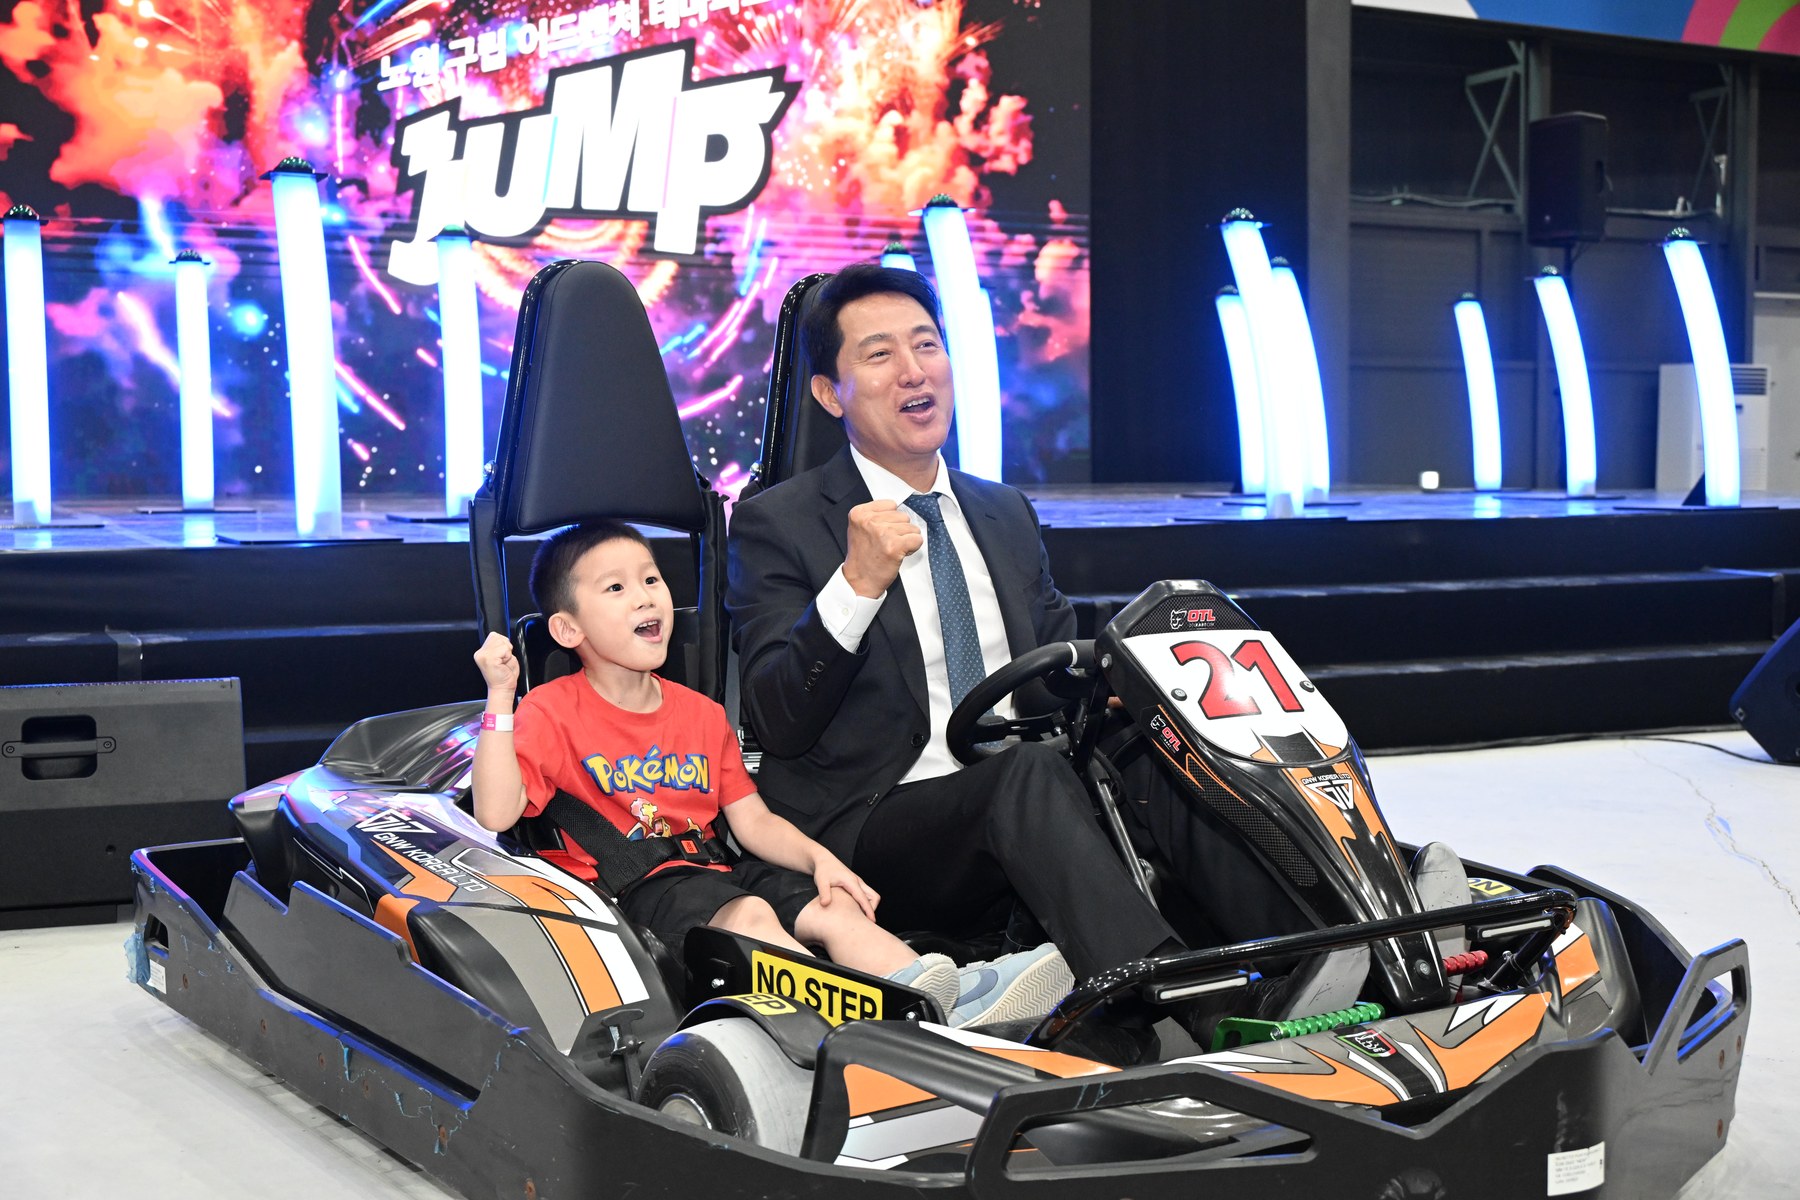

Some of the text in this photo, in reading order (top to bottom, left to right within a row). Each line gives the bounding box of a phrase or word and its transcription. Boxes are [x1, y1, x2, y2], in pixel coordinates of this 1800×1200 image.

[377, 43, 441, 91] 노원
[1187, 609, 1216, 622] OTL
[1170, 640, 1304, 719] 21
[1162, 727, 1181, 751] OTL
[374, 832, 416, 850] GNW
[403, 849, 460, 877] KOREA
[757, 961, 878, 1021] NO STEP
